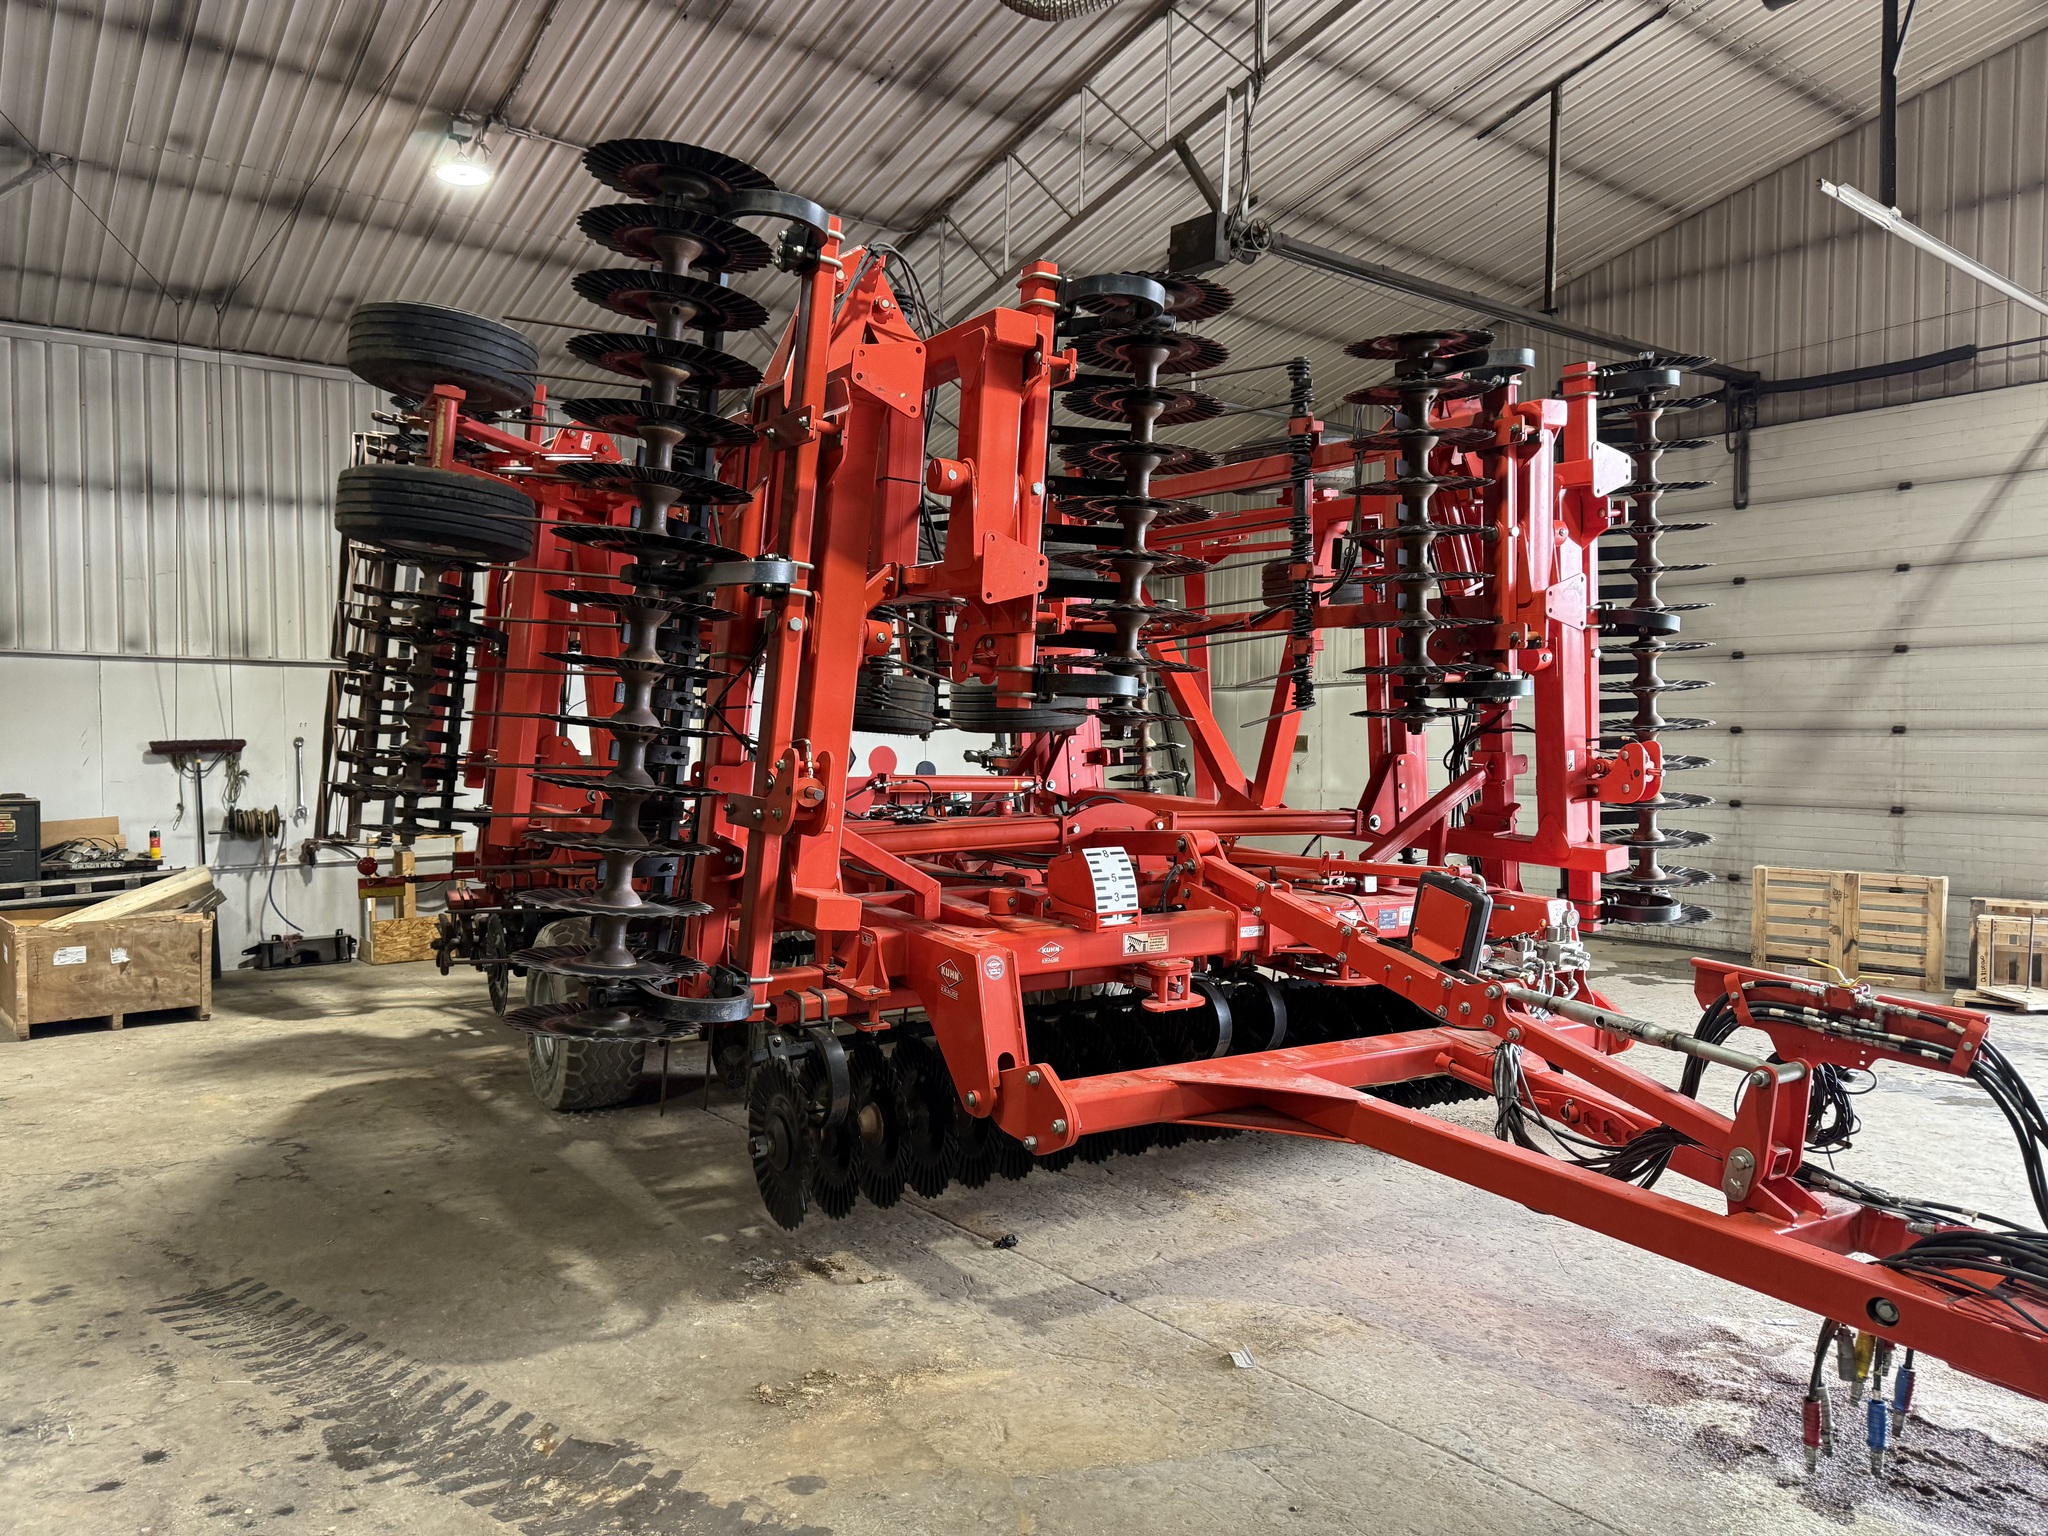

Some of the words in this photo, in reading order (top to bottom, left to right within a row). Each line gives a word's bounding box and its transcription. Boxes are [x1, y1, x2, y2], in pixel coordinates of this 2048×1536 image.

[1102, 850, 1109, 858] 8
[1111, 873, 1117, 882] 5
[1114, 892, 1120, 902] 3
[940, 965, 959, 981] KUHN
